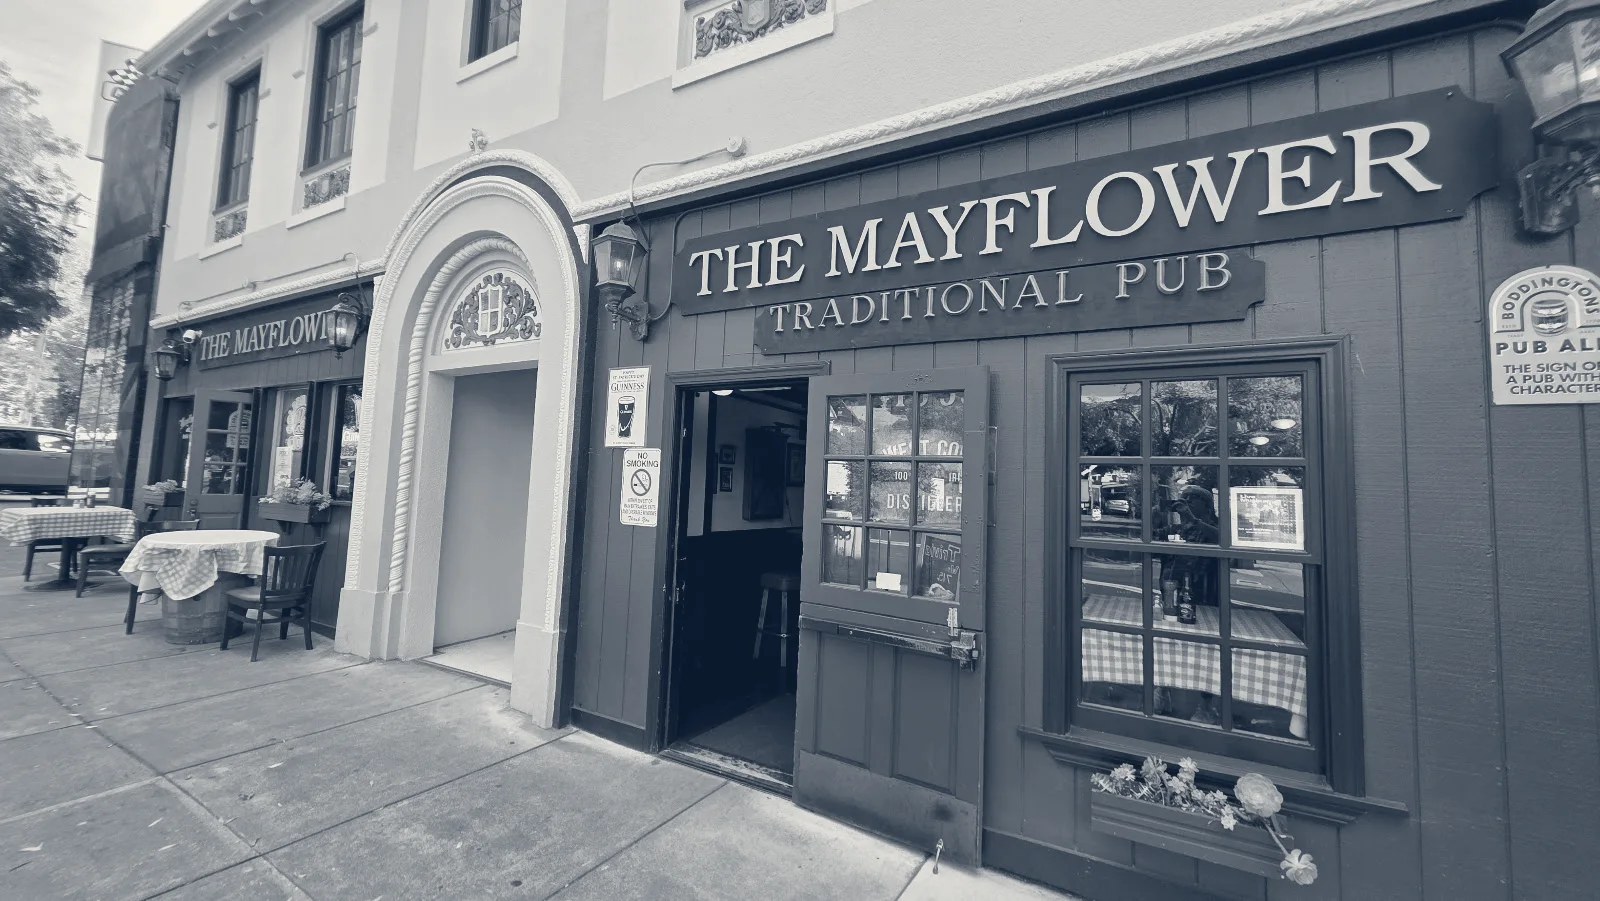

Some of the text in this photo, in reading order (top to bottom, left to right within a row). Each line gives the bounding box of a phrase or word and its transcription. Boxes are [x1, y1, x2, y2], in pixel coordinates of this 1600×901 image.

[688, 121, 1443, 296] THE MAYFLOWER
[770, 252, 1232, 332] TRADITIONAL PUB
[1502, 277, 1600, 320] BODDINGTONS
[200, 311, 328, 361] THE MAYFLOW
[1496, 340, 1548, 355] PUB
[1503, 364, 1531, 373] THE
[1536, 362, 1577, 373] SIGN
[1506, 376, 1518, 384] A
[1522, 374, 1555, 384] PUB
[611, 382, 645, 391] GUINNESS
[637, 452, 648, 460] NO
[626, 460, 659, 468] SMOKING
